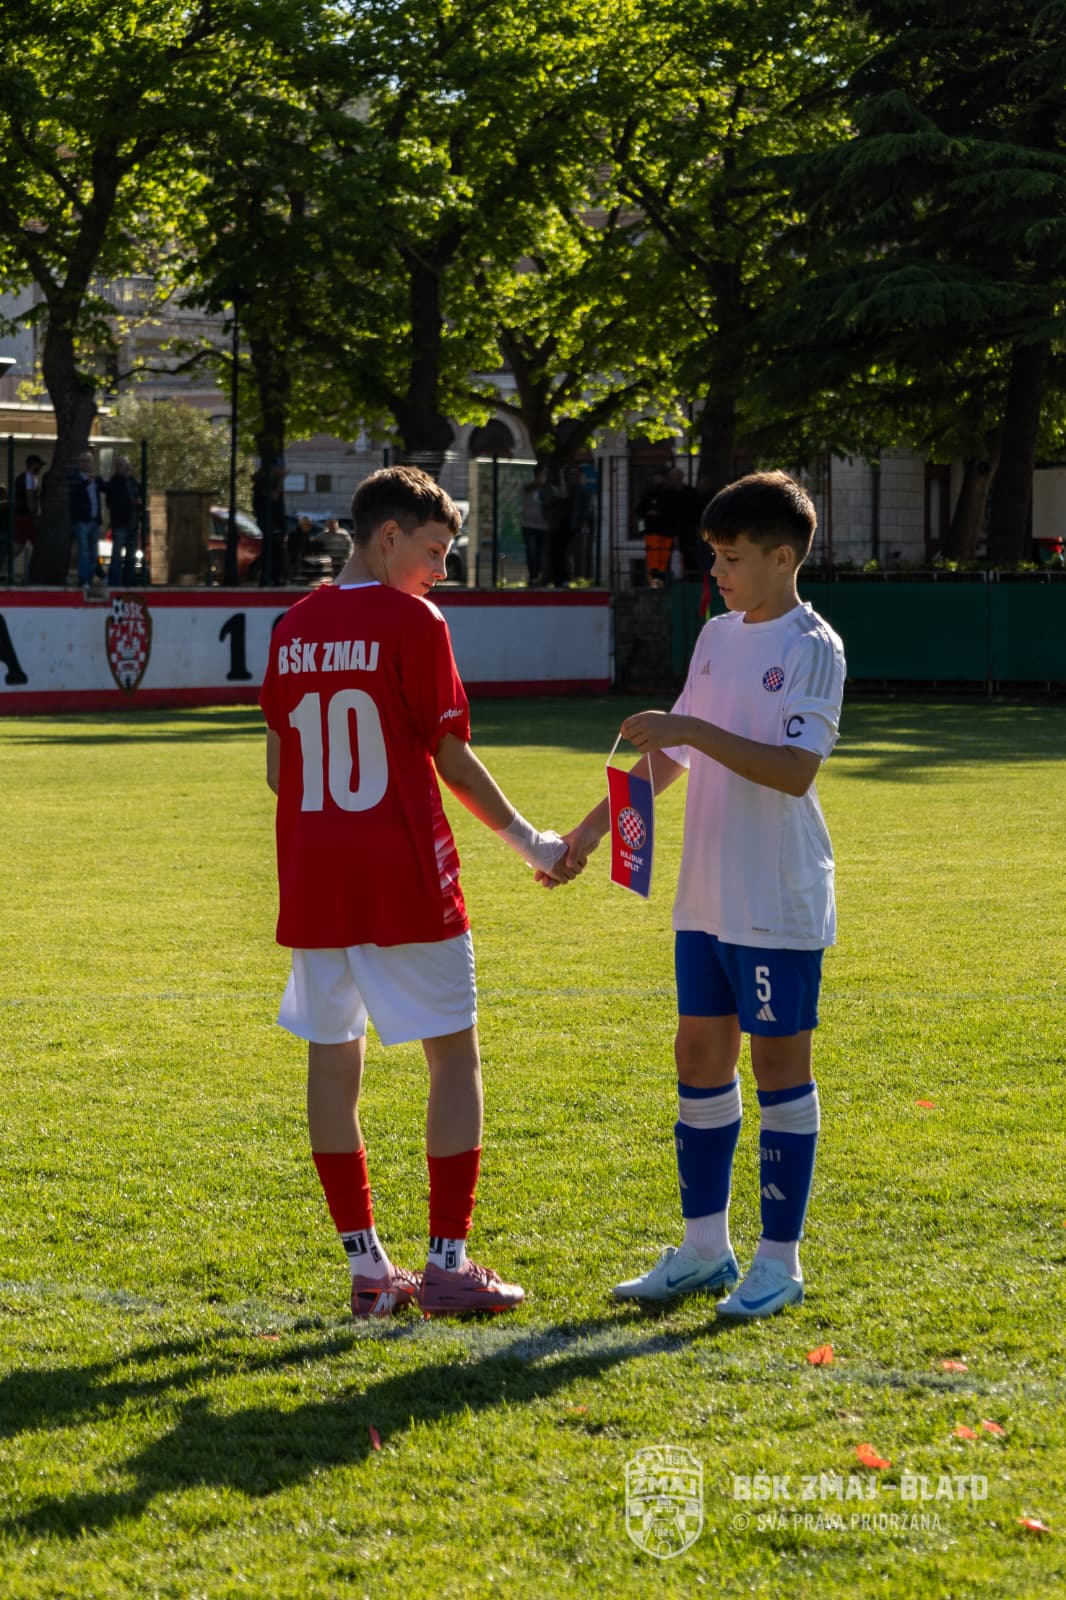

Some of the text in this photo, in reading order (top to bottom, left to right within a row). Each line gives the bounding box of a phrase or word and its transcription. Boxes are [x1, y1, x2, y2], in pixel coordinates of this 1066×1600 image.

[278, 637, 380, 675] BŠK ZMAJ
[786, 715, 805, 738] C
[288, 688, 389, 812] 10
[620, 849, 644, 865] HAJDUK
[624, 860, 640, 873] SPLIT
[755, 965, 772, 1002] 5
